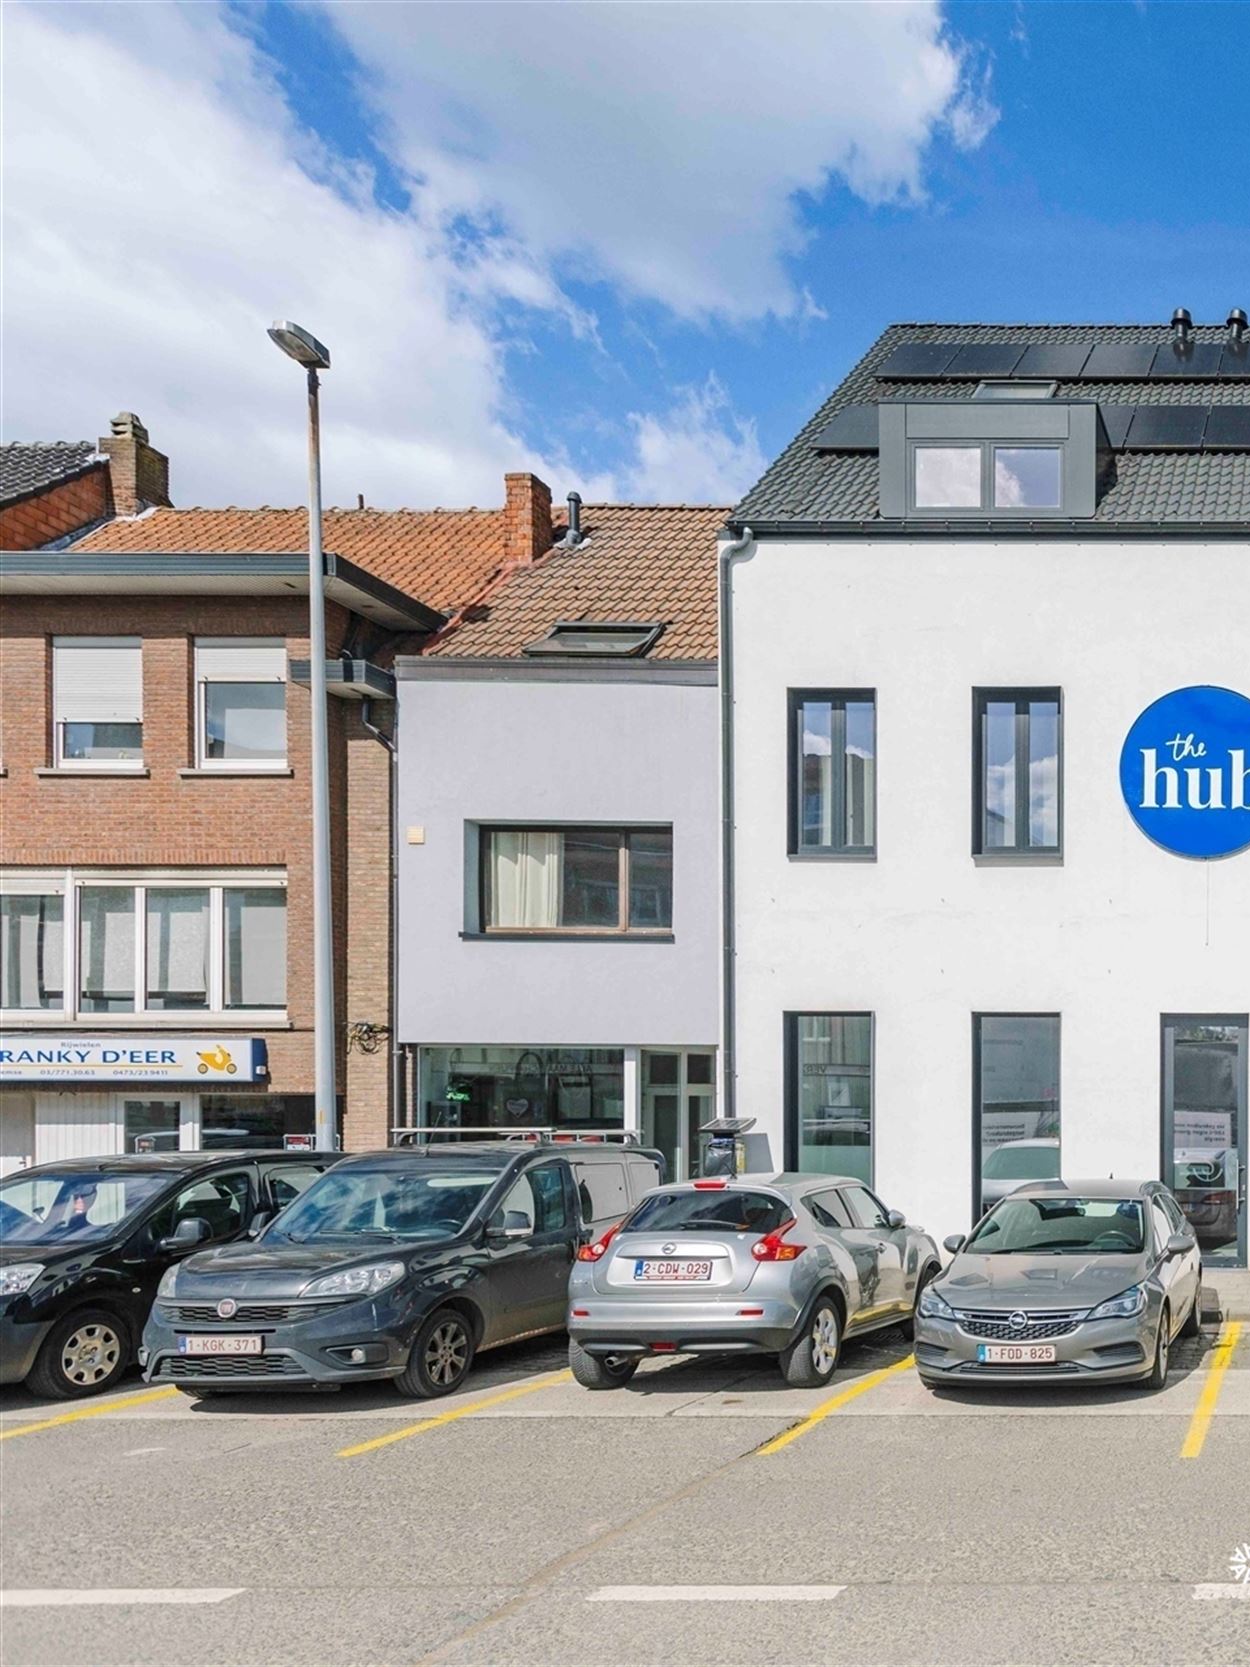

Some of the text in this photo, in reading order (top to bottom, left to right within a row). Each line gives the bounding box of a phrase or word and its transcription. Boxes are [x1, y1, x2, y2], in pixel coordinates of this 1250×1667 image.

[1165, 732, 1207, 761] the
[102, 1050, 176, 1063] D'EER
[644, 1263, 709, 1275] 2-CDW-029
[188, 1339, 257, 1351] 1-KGK-371
[987, 1348, 1053, 1359] 1-FOD-825
